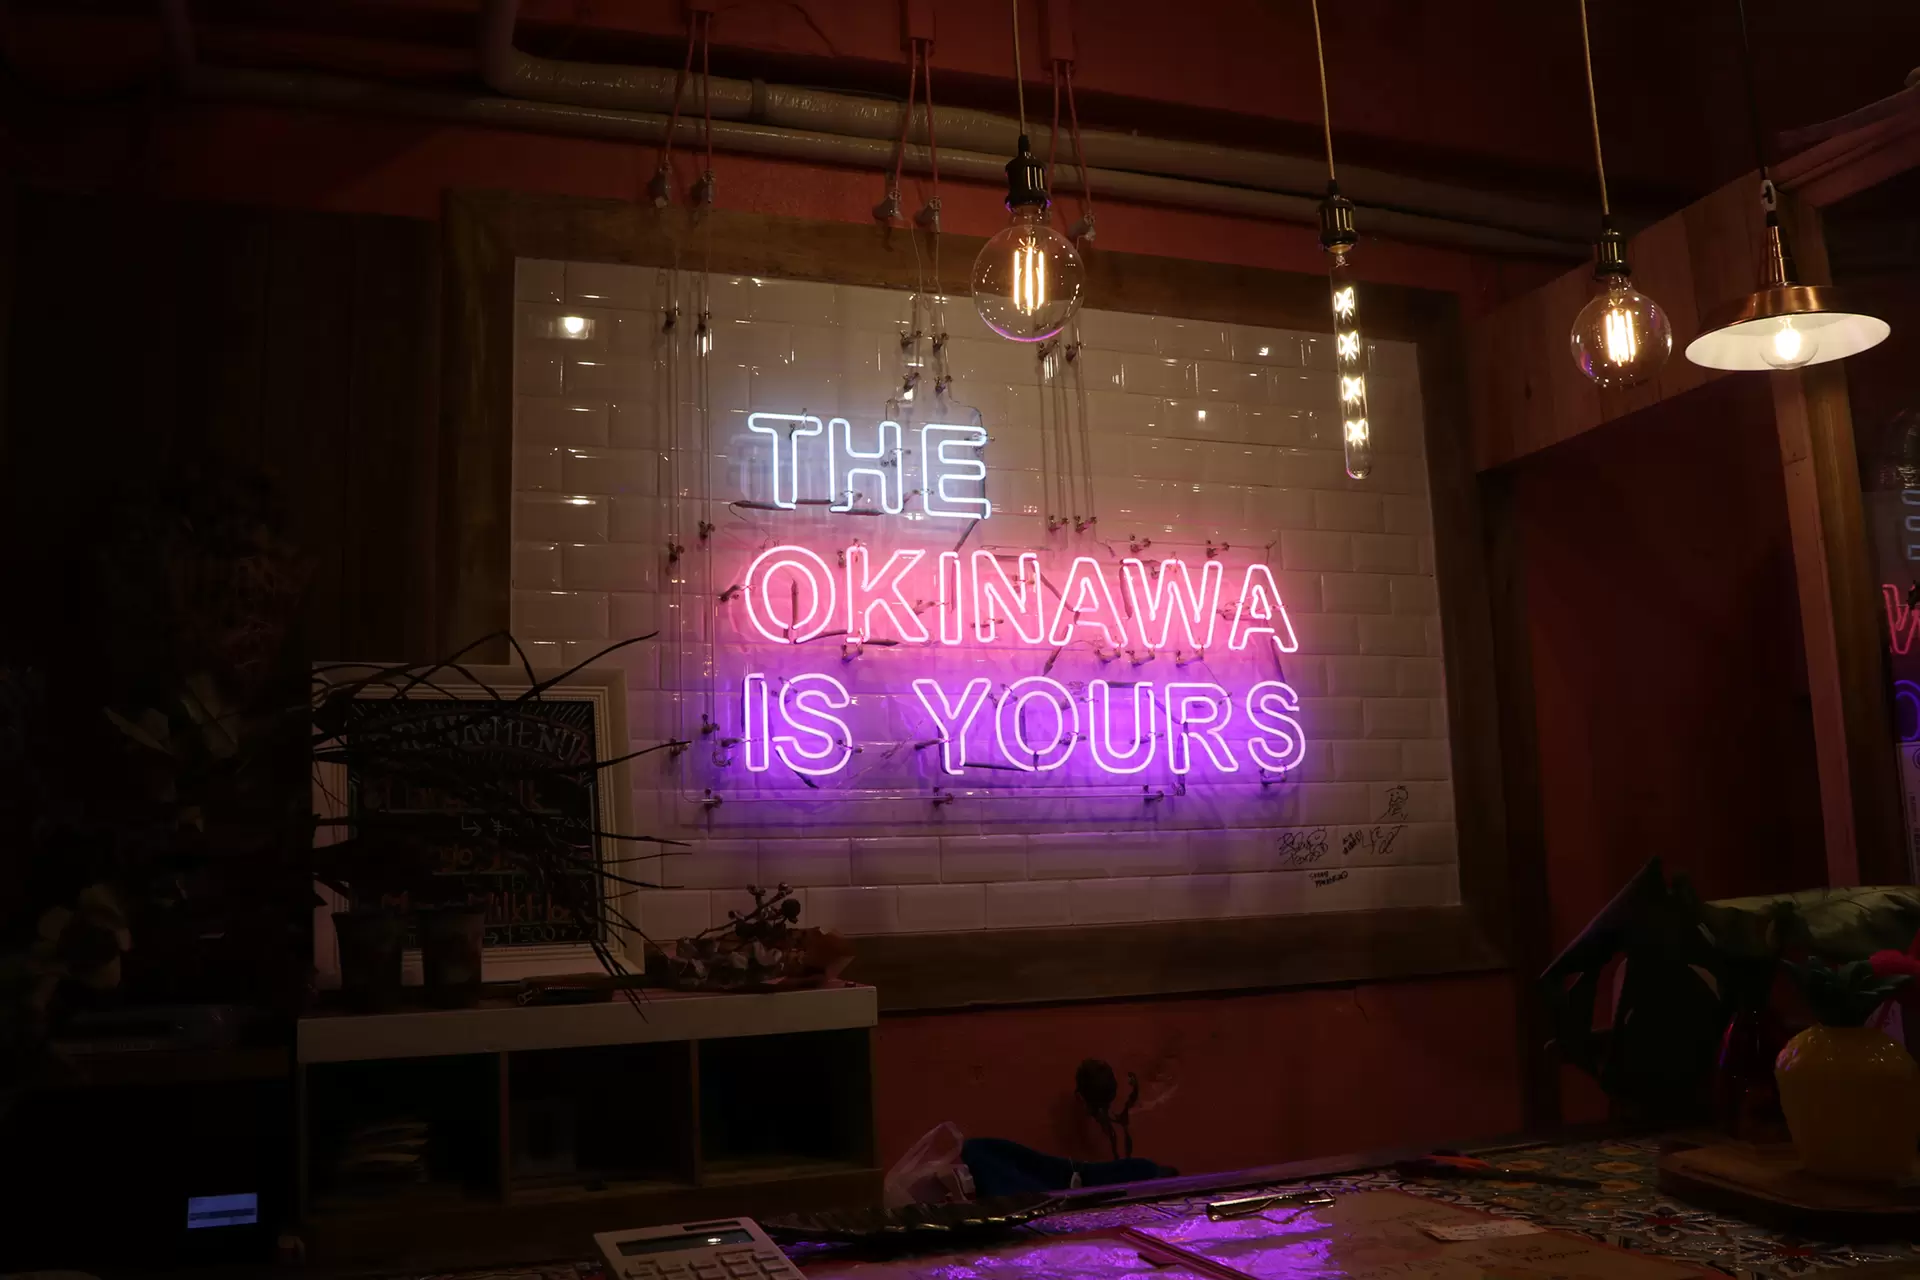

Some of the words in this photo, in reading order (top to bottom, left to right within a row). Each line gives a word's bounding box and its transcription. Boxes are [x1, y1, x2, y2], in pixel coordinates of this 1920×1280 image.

[747, 411, 992, 520] THE
[743, 544, 1299, 653] OKINAWA
[489, 714, 582, 761] MENU
[743, 671, 853, 777] IS
[911, 674, 1307, 776] YOURS
